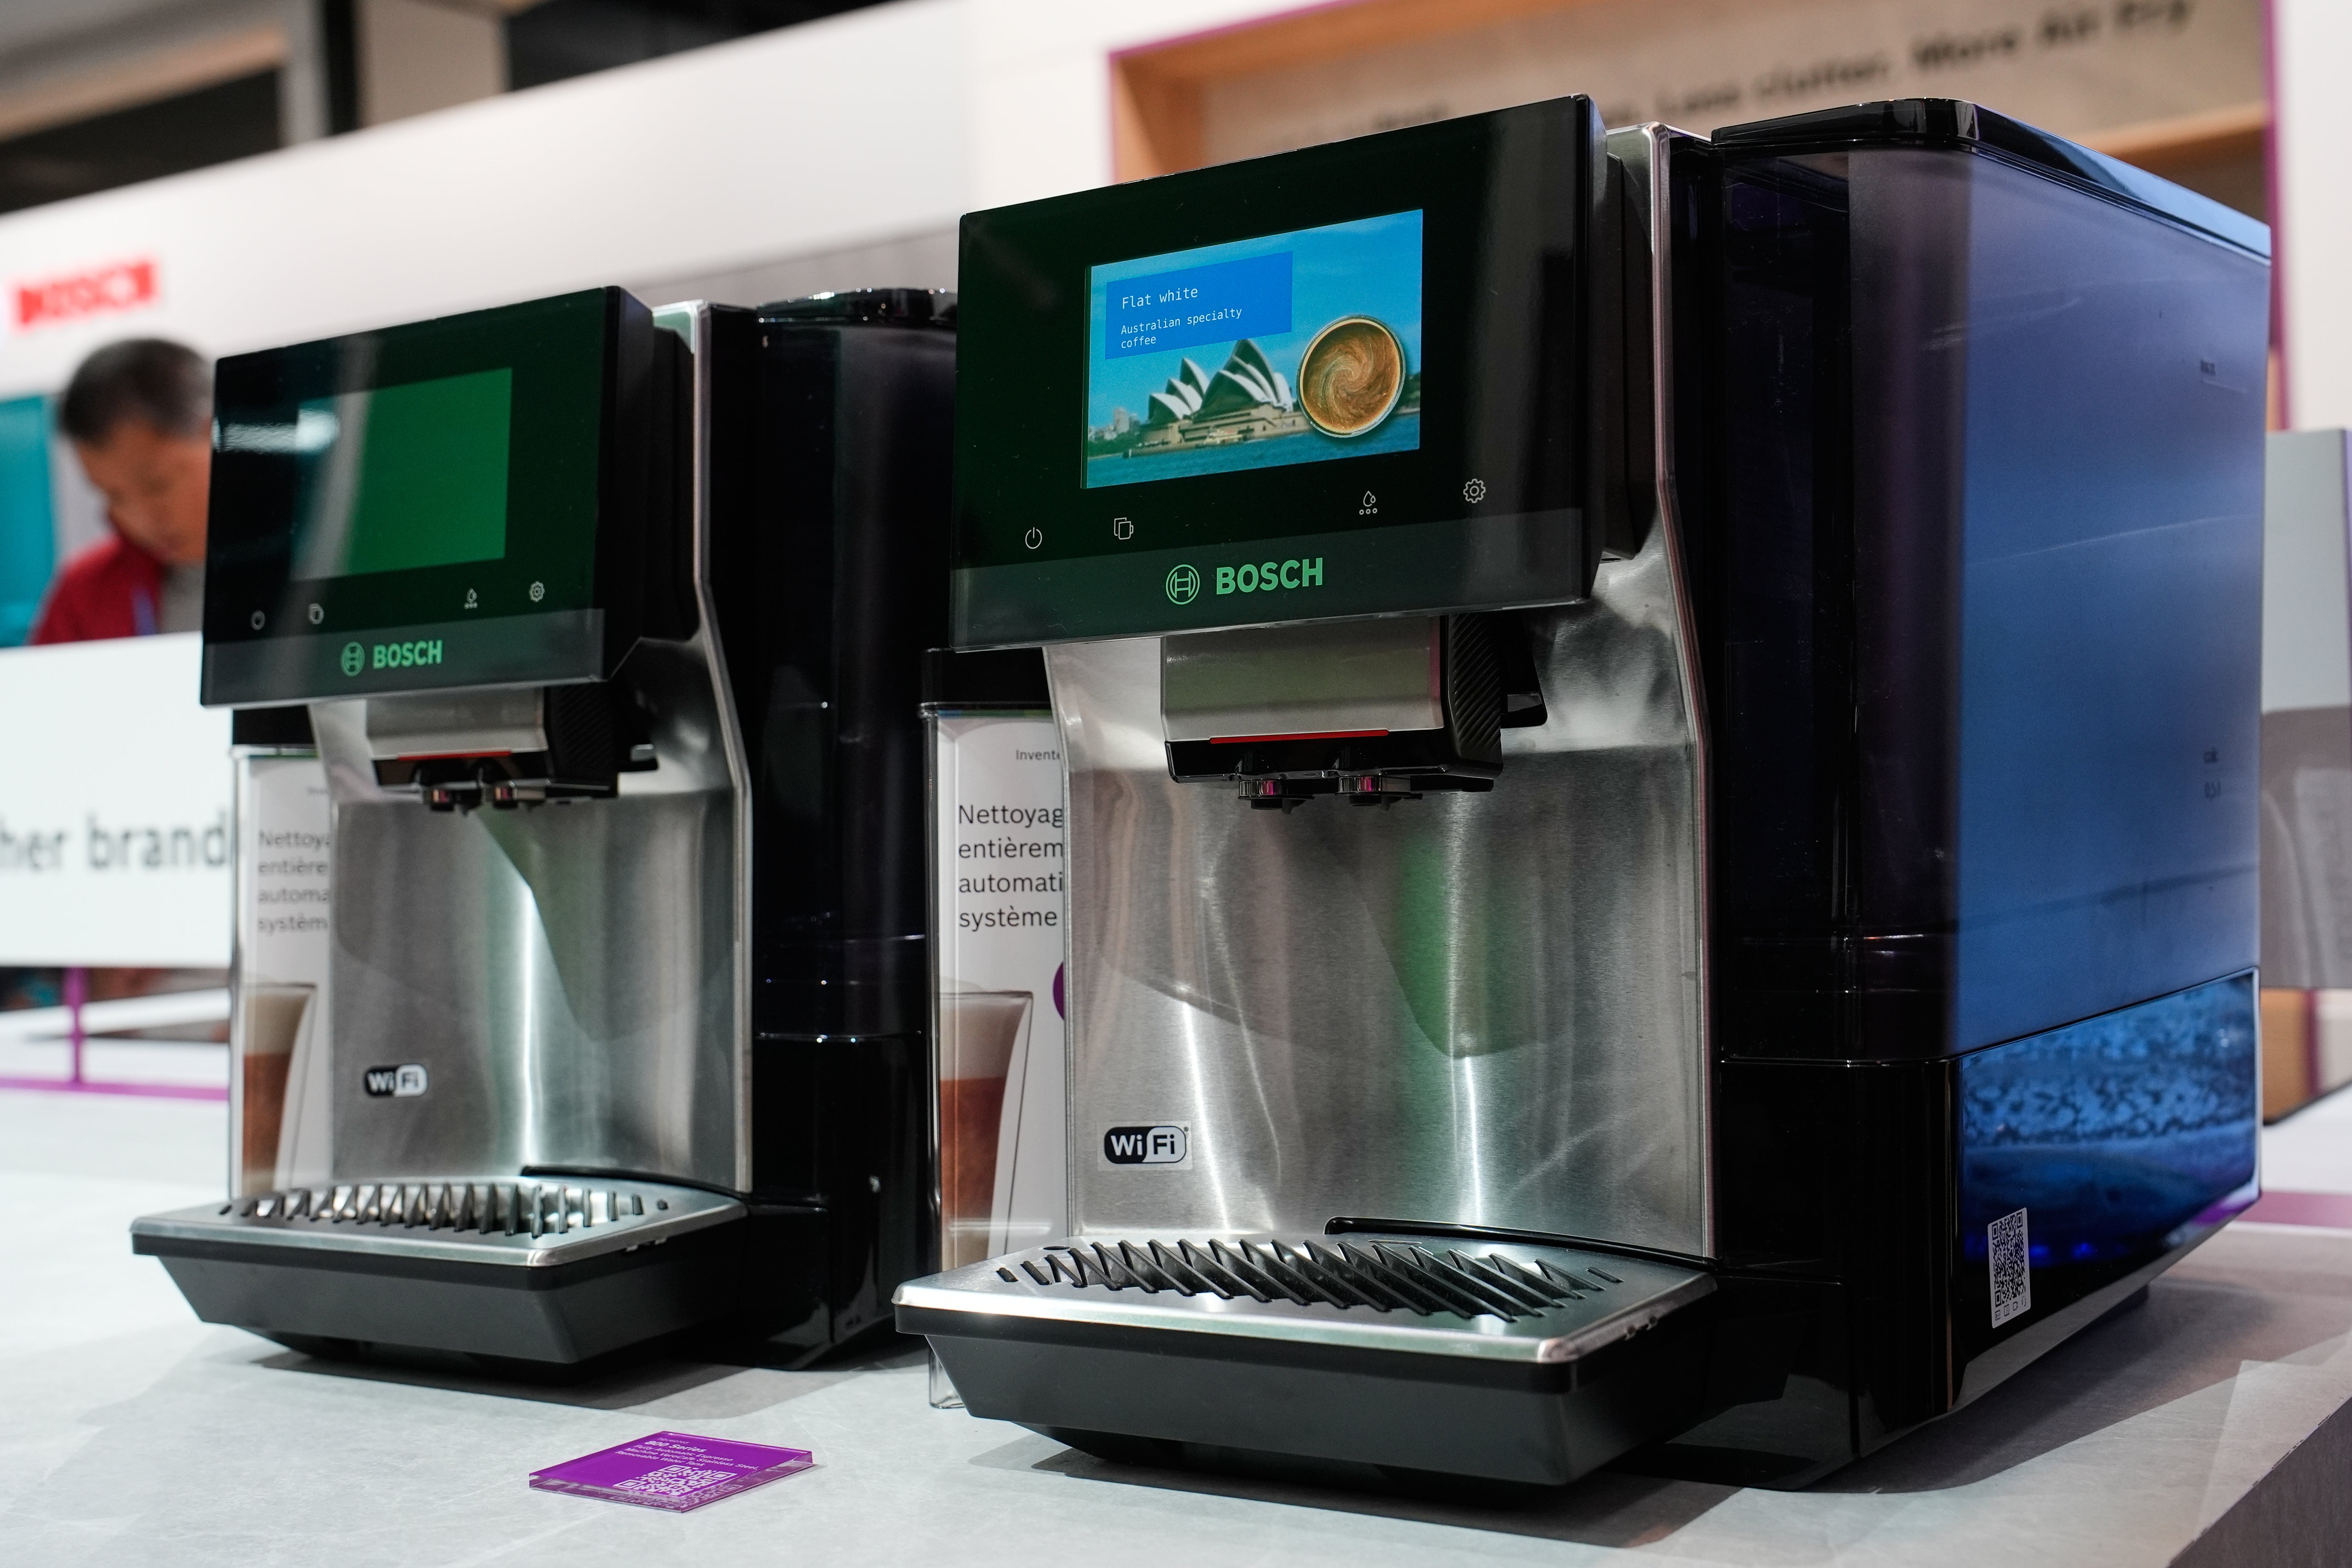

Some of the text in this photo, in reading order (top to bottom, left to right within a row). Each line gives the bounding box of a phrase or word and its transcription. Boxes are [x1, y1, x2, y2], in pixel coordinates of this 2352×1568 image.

[1122, 288, 1198, 309] Flat white
[1120, 308, 1242, 335] Australian specialty
[1120, 336, 1156, 349] coffee
[1216, 557, 1323, 595] BOSCH
[373, 639, 443, 670] BOSCH
[959, 905, 1057, 932] système
[615, 1450, 659, 1460] Removable
[654, 1448, 696, 1456] Automatic
[696, 1453, 733, 1461] Espresso
[668, 1444, 707, 1452] Series
